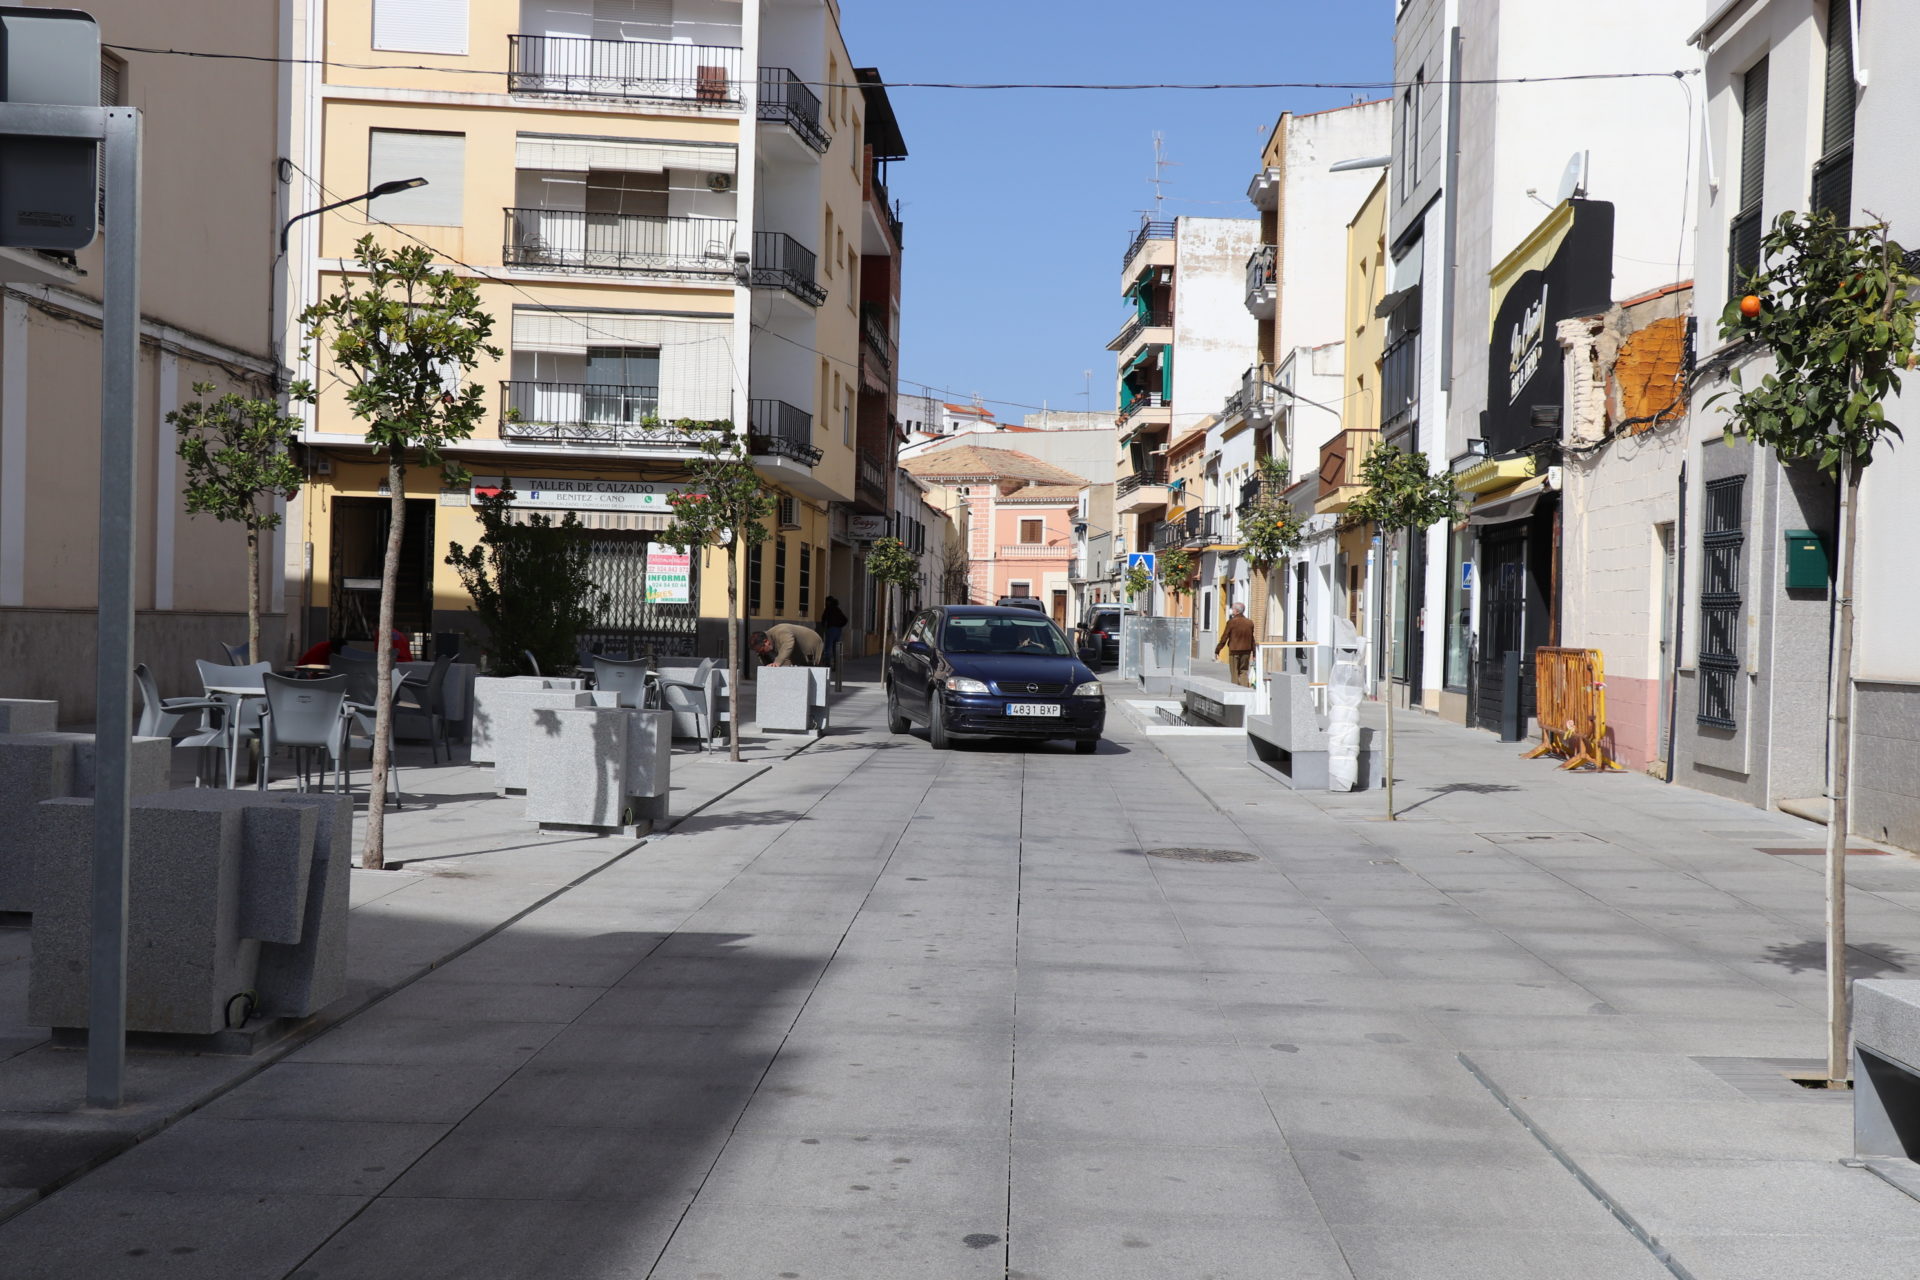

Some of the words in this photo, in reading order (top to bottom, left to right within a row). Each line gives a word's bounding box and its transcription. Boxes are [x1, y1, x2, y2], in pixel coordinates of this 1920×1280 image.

[529, 480, 573, 491] TALLER
[577, 482, 593, 492] DE
[596, 482, 654, 494] CALZADO
[600, 495, 625, 503] CANO
[1013, 705, 1037, 715] 4831
[1040, 705, 1058, 715] BXP
